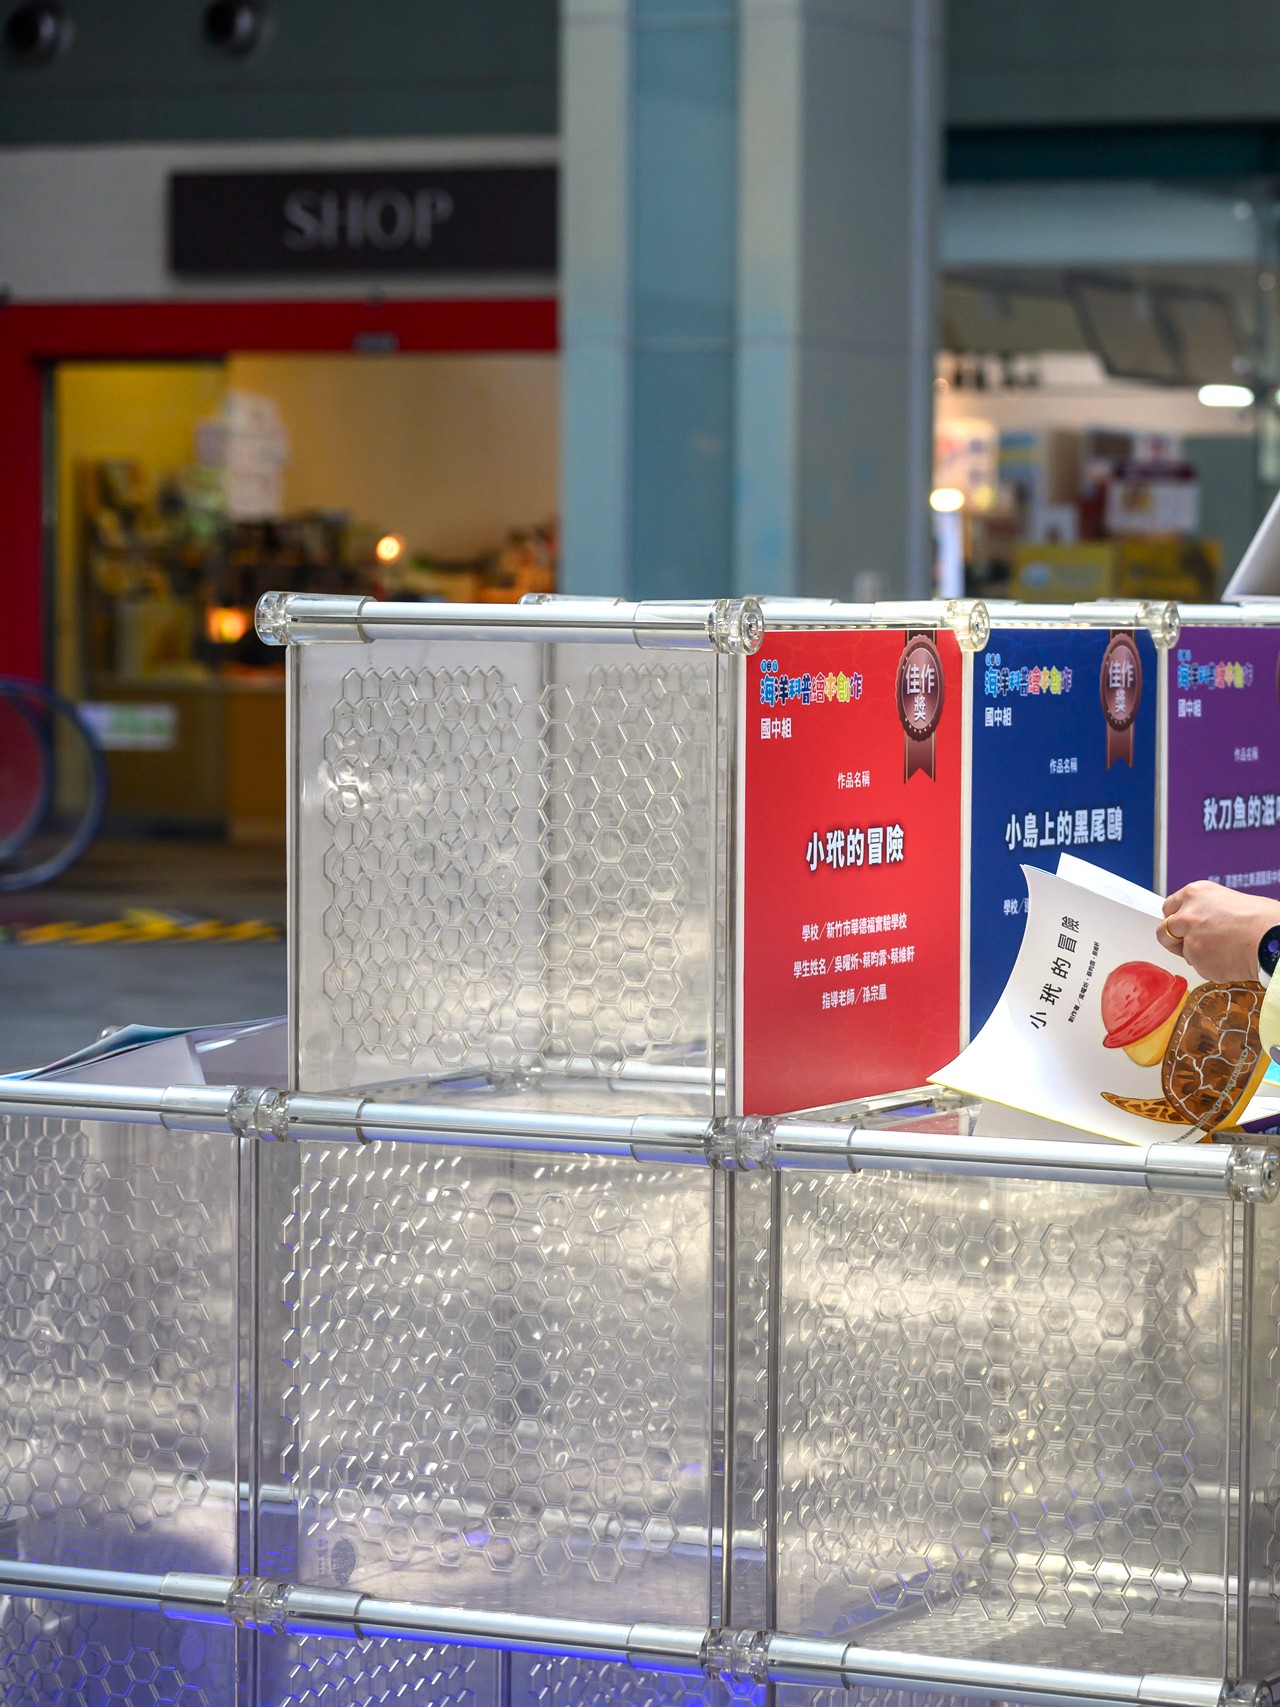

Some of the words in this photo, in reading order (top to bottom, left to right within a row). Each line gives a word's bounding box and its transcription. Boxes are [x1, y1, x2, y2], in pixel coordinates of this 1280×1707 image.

[284, 187, 455, 251] SHOP
[760, 671, 863, 707] 海洋科普繪本創作
[906, 664, 935, 695] 佳作
[1108, 660, 1134, 689] 佳作
[914, 696, 927, 722] 獎
[985, 707, 1012, 727] 國中組
[761, 718, 792, 739] 國中組
[837, 770, 870, 789] 作品名稱
[1049, 758, 1078, 774] 作品名稱
[1005, 806, 1123, 850] 小島上的黑尾鷗
[805, 824, 904, 872] 小玳的冒險
[1030, 916, 1079, 1029] 小玳的冒險
